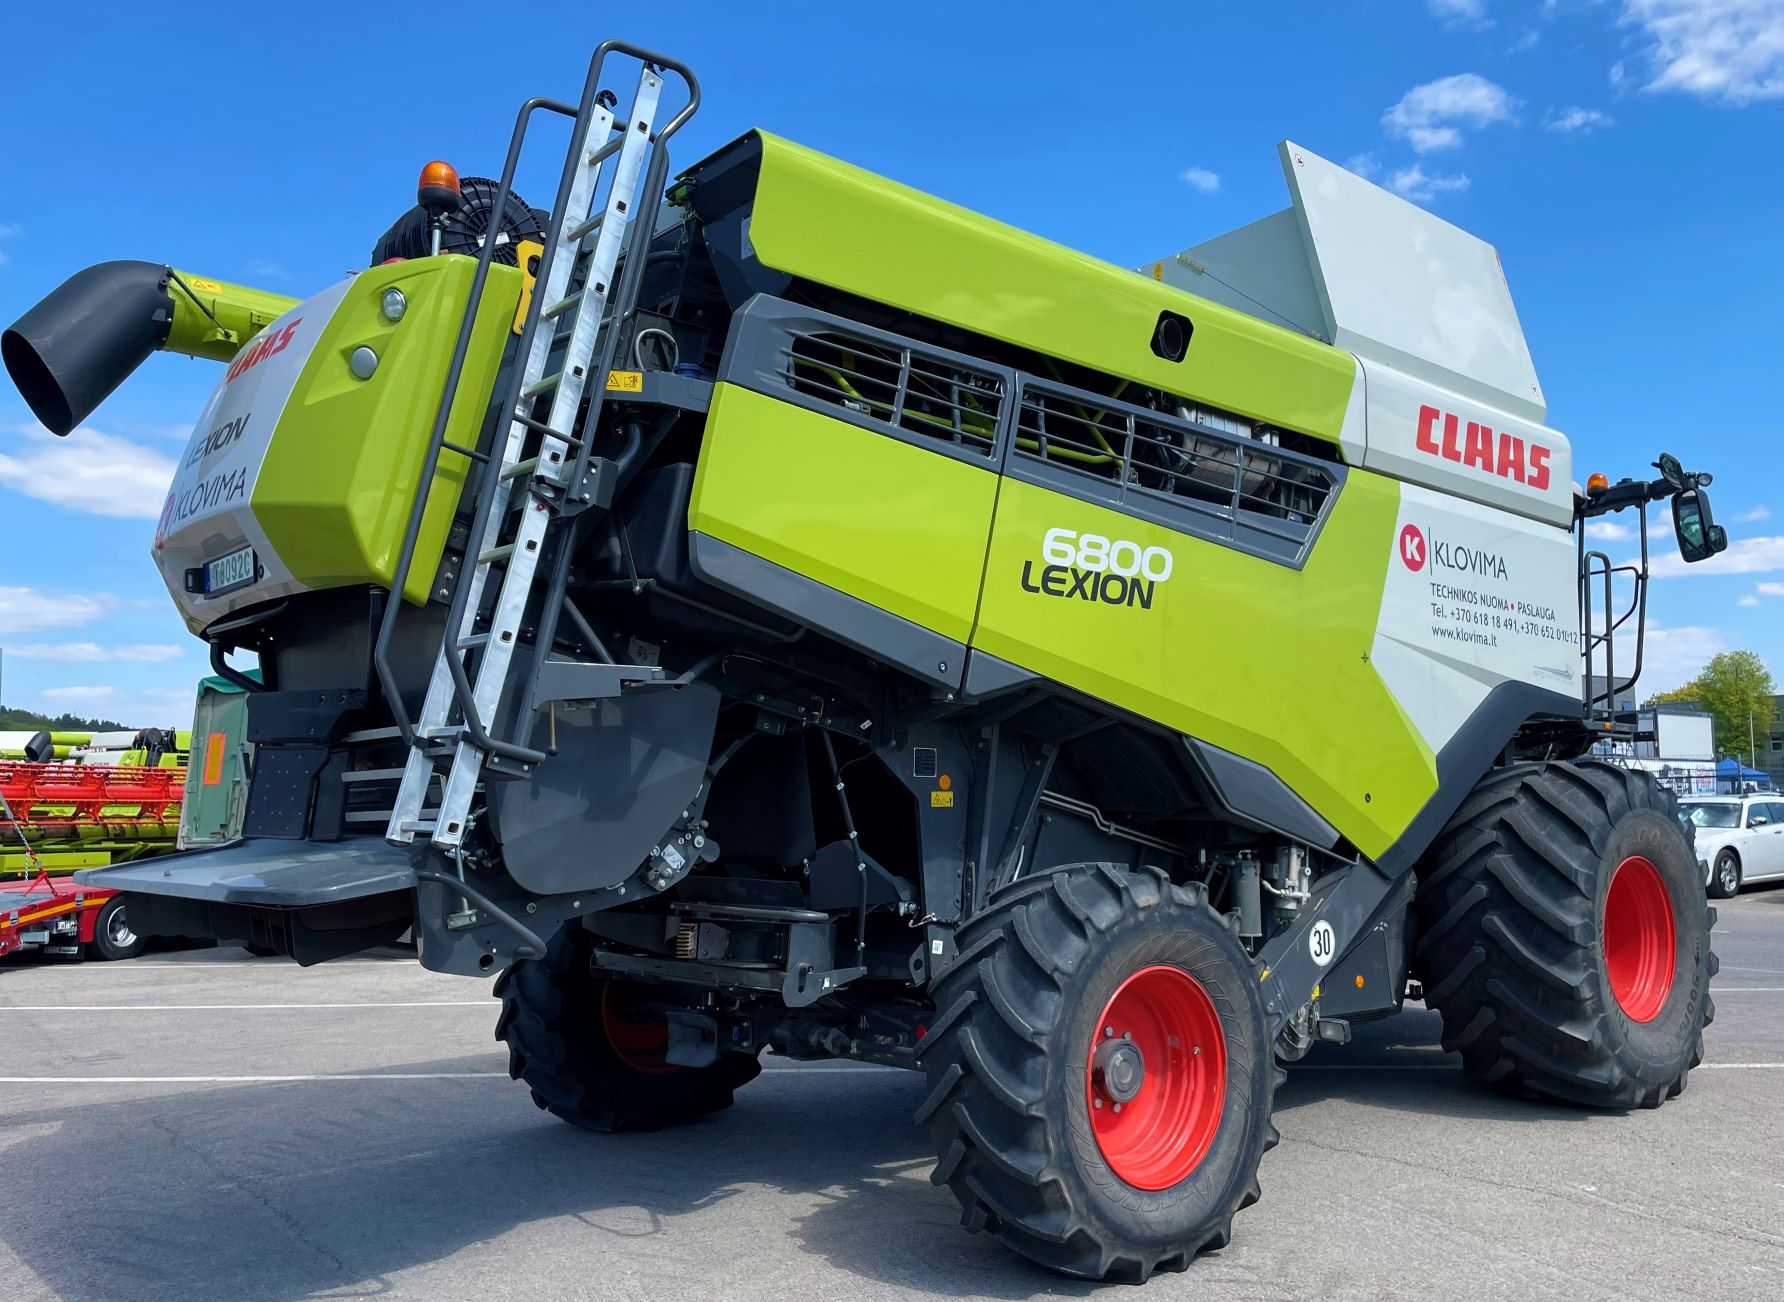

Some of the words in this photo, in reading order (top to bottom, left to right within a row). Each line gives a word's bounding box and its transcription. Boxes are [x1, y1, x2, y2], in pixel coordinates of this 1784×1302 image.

[185, 412, 251, 470] LEXION
[1415, 404, 1551, 490] CLAAS
[173, 466, 247, 524] KLOVIMA
[1042, 527, 1173, 582] 6800
[1404, 534, 1421, 562] K
[1434, 540, 1508, 581] KLOVIMA
[1021, 560, 1155, 610] LEXION
[1430, 582, 1478, 605] TECHNIKOS
[1480, 594, 1509, 612] NUOMA
[1517, 601, 1556, 622] PASLAUGA
[1431, 602, 1447, 619] Tel.
[1450, 607, 1471, 623] +370
[1473, 611, 1489, 626] 618
[1491, 615, 1501, 629] 18
[1540, 625, 1555, 640] 652
[1431, 625, 1498, 648] www.klovima.lt
[1313, 928, 1331, 958] 30
